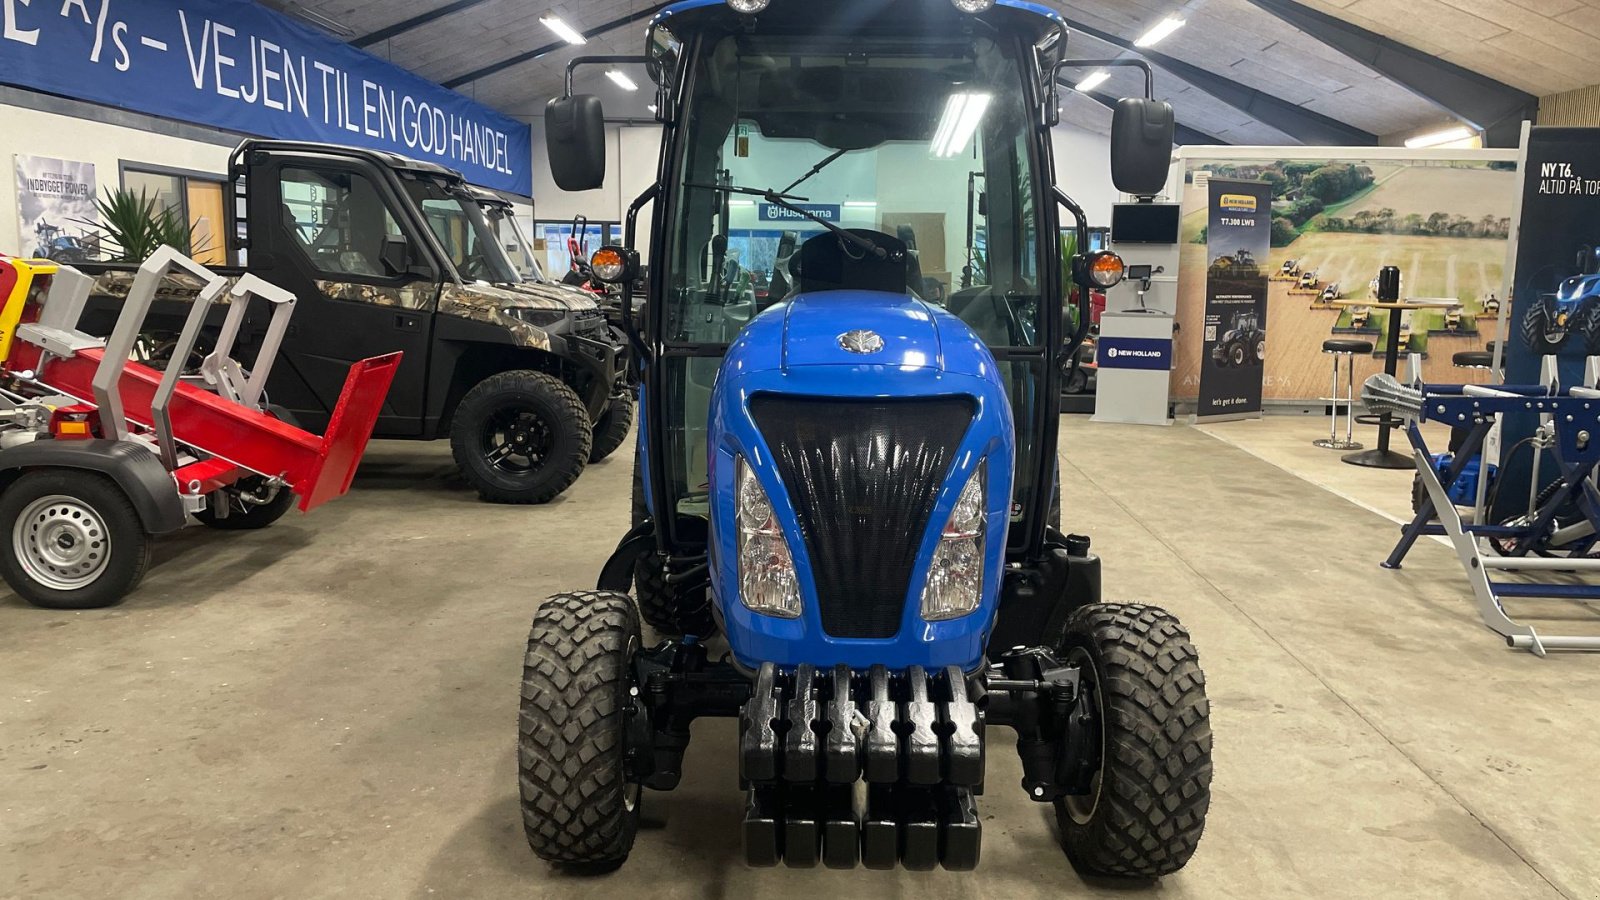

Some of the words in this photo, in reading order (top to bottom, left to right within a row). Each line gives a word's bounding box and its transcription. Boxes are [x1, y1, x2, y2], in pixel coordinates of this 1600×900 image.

[178, 9, 309, 118] VEJEN
[313, 60, 360, 133] TIL
[362, 79, 397, 142] EN
[401, 95, 447, 156] GOD
[450, 113, 513, 175] HANDEL
[1541, 162, 1557, 178] NY
[1558, 163, 1574, 178] T6.
[27, 178, 64, 194] INDBYGGET
[65, 182, 88, 196] POWER
[1538, 179, 1567, 195] ALTID
[1569, 176, 1582, 195] PÅ
[1221, 218, 1240, 226] T7.300
